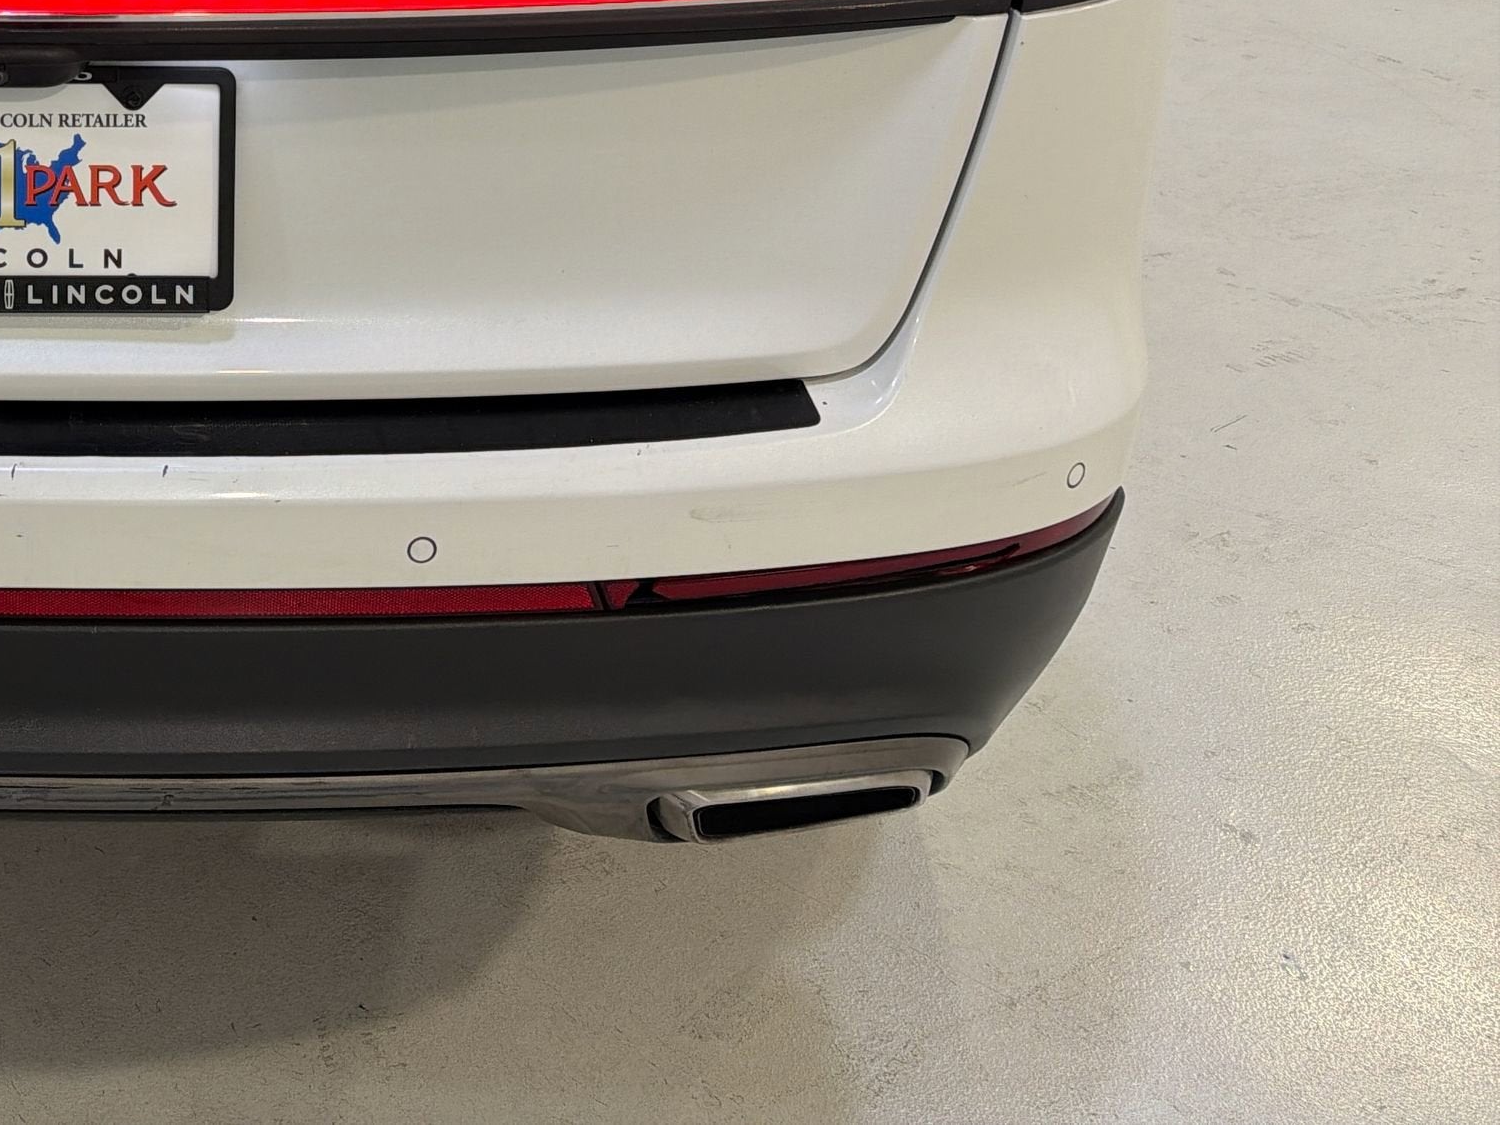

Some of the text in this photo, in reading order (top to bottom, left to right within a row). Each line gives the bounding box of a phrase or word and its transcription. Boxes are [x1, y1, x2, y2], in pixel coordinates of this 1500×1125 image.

[58, 113, 147, 128] RETAILER
[24, 163, 178, 207] PARK
[27, 284, 194, 305] LINCOLN
